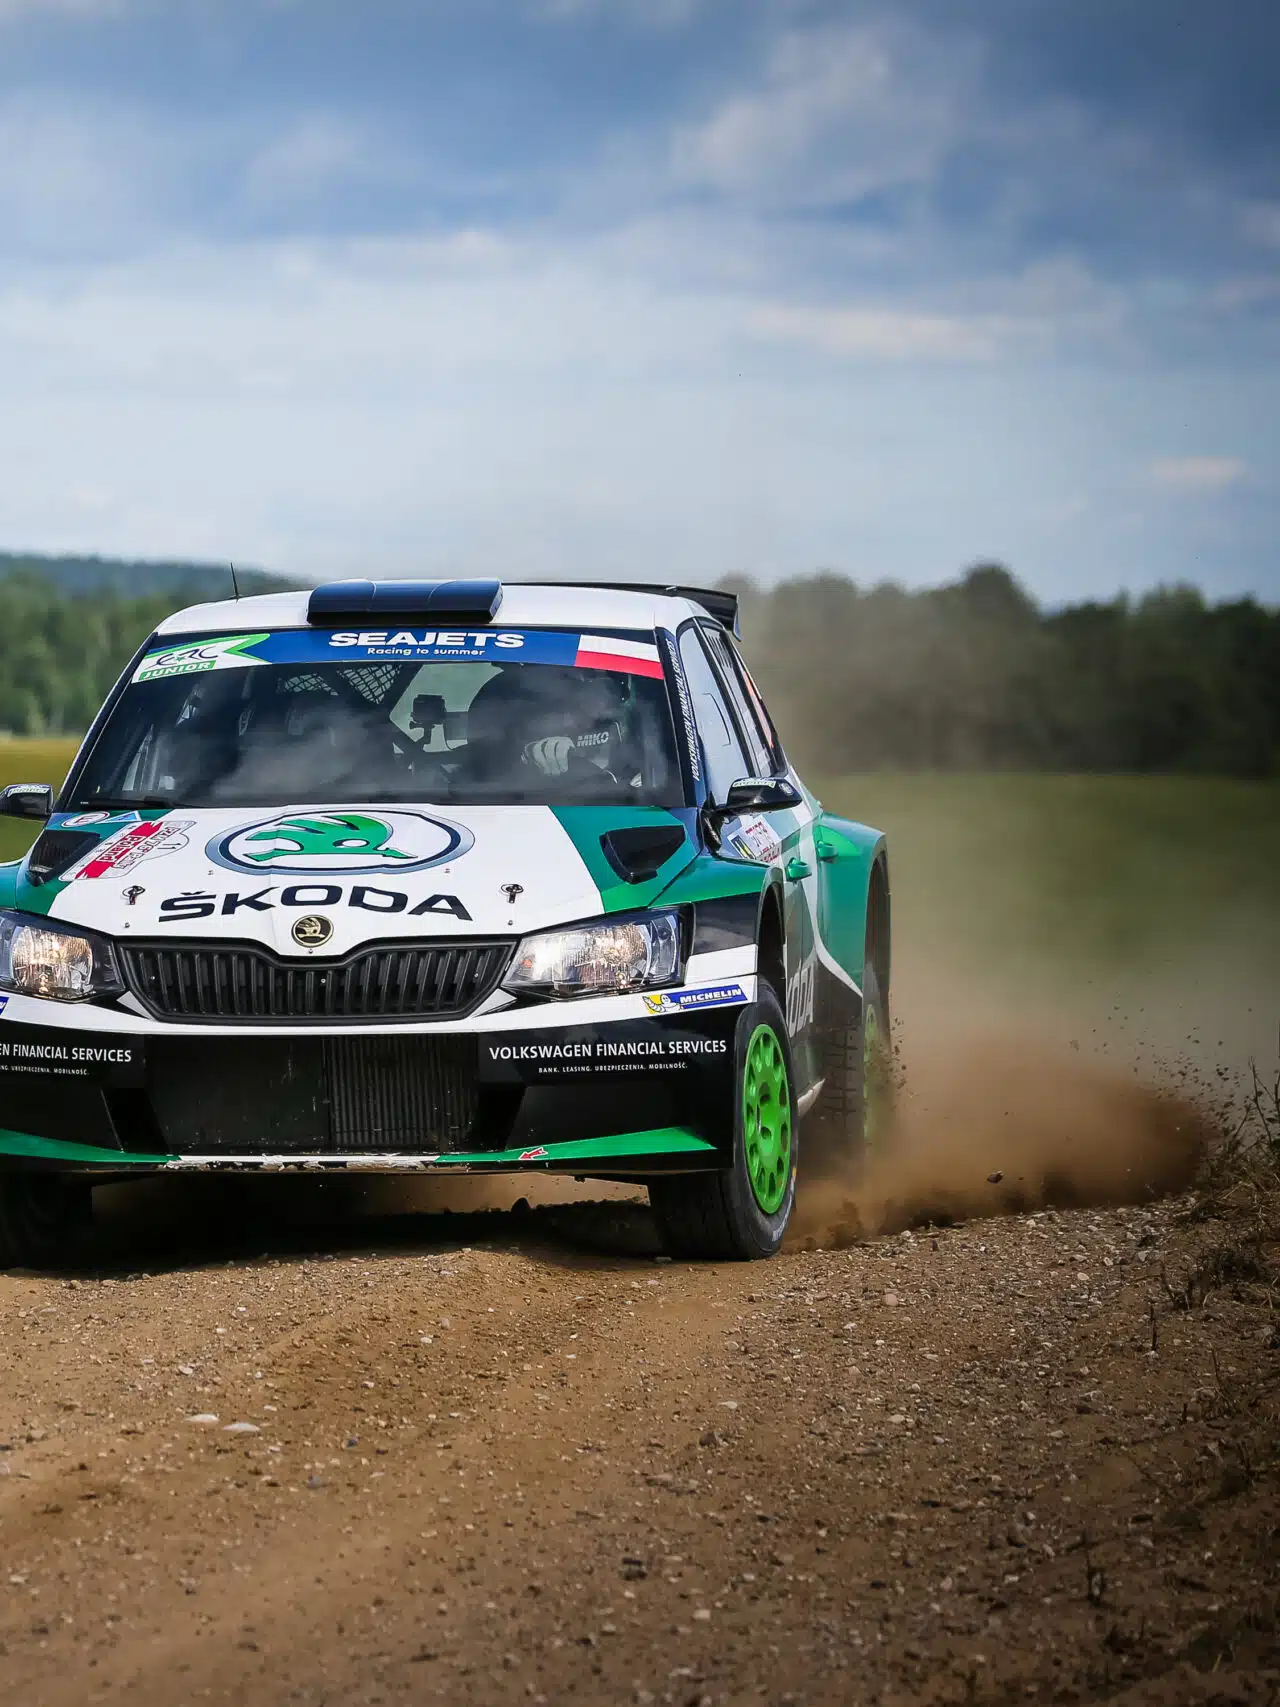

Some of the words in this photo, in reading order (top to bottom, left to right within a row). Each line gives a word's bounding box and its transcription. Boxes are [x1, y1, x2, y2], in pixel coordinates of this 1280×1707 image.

[328, 631, 525, 648] SEAJETS
[367, 647, 412, 656] Racing
[433, 648, 486, 656] summer
[143, 661, 211, 680] JUNIOR
[576, 731, 609, 747] MIKO
[97, 834, 146, 862] Poland
[158, 884, 474, 923] ŠKODA
[681, 988, 742, 1004] MICHELIN
[13, 1044, 68, 1060] FINANCIAL
[71, 1047, 132, 1062] SERVICES
[489, 1044, 592, 1060] VOLKSWAGEN
[596, 1042, 666, 1057] FINANCIAL
[669, 1040, 727, 1054] SERVICES
[538, 1066, 560, 1074] BANK.
[562, 1065, 593, 1073] LEASING.
